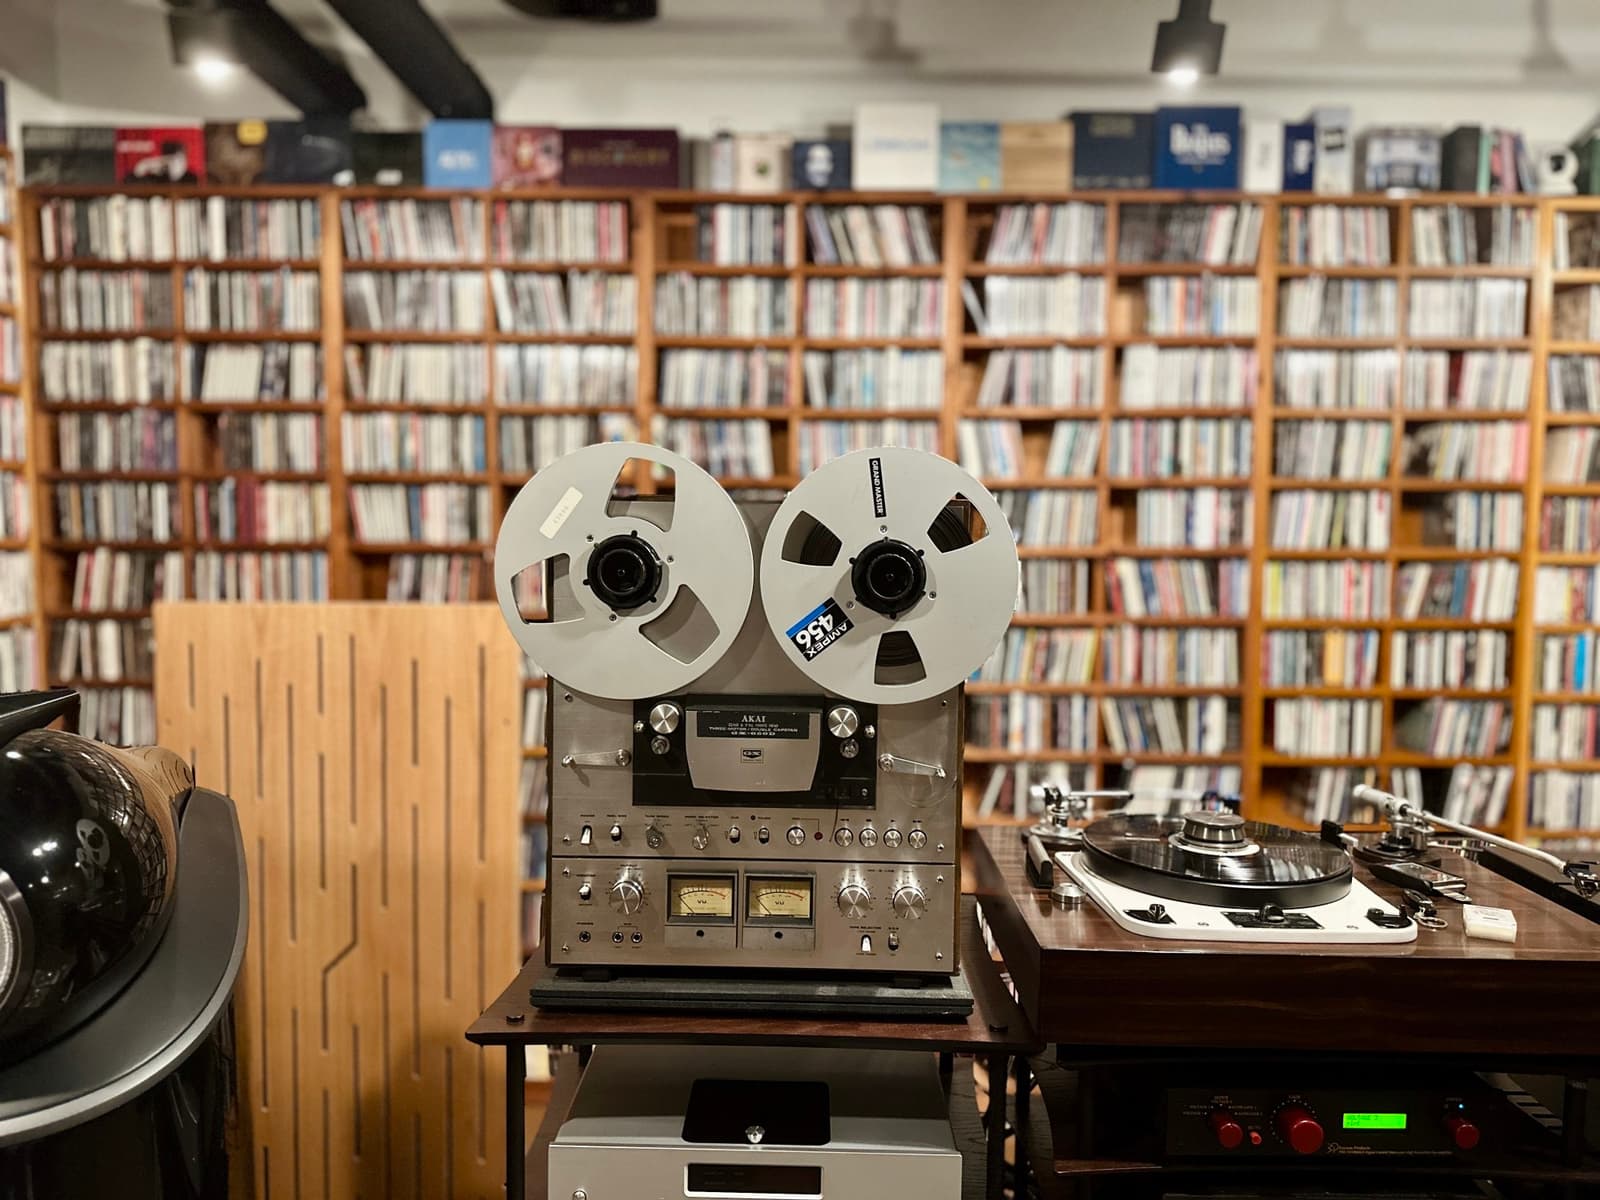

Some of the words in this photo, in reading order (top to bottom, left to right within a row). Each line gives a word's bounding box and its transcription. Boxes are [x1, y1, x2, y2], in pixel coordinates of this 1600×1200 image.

[871, 460, 880, 486] GRAND
[875, 487, 884, 514] MASTER
[796, 614, 833, 649] 456
[807, 622, 847, 657] AMPEX
[741, 715, 767, 723] AKAI
